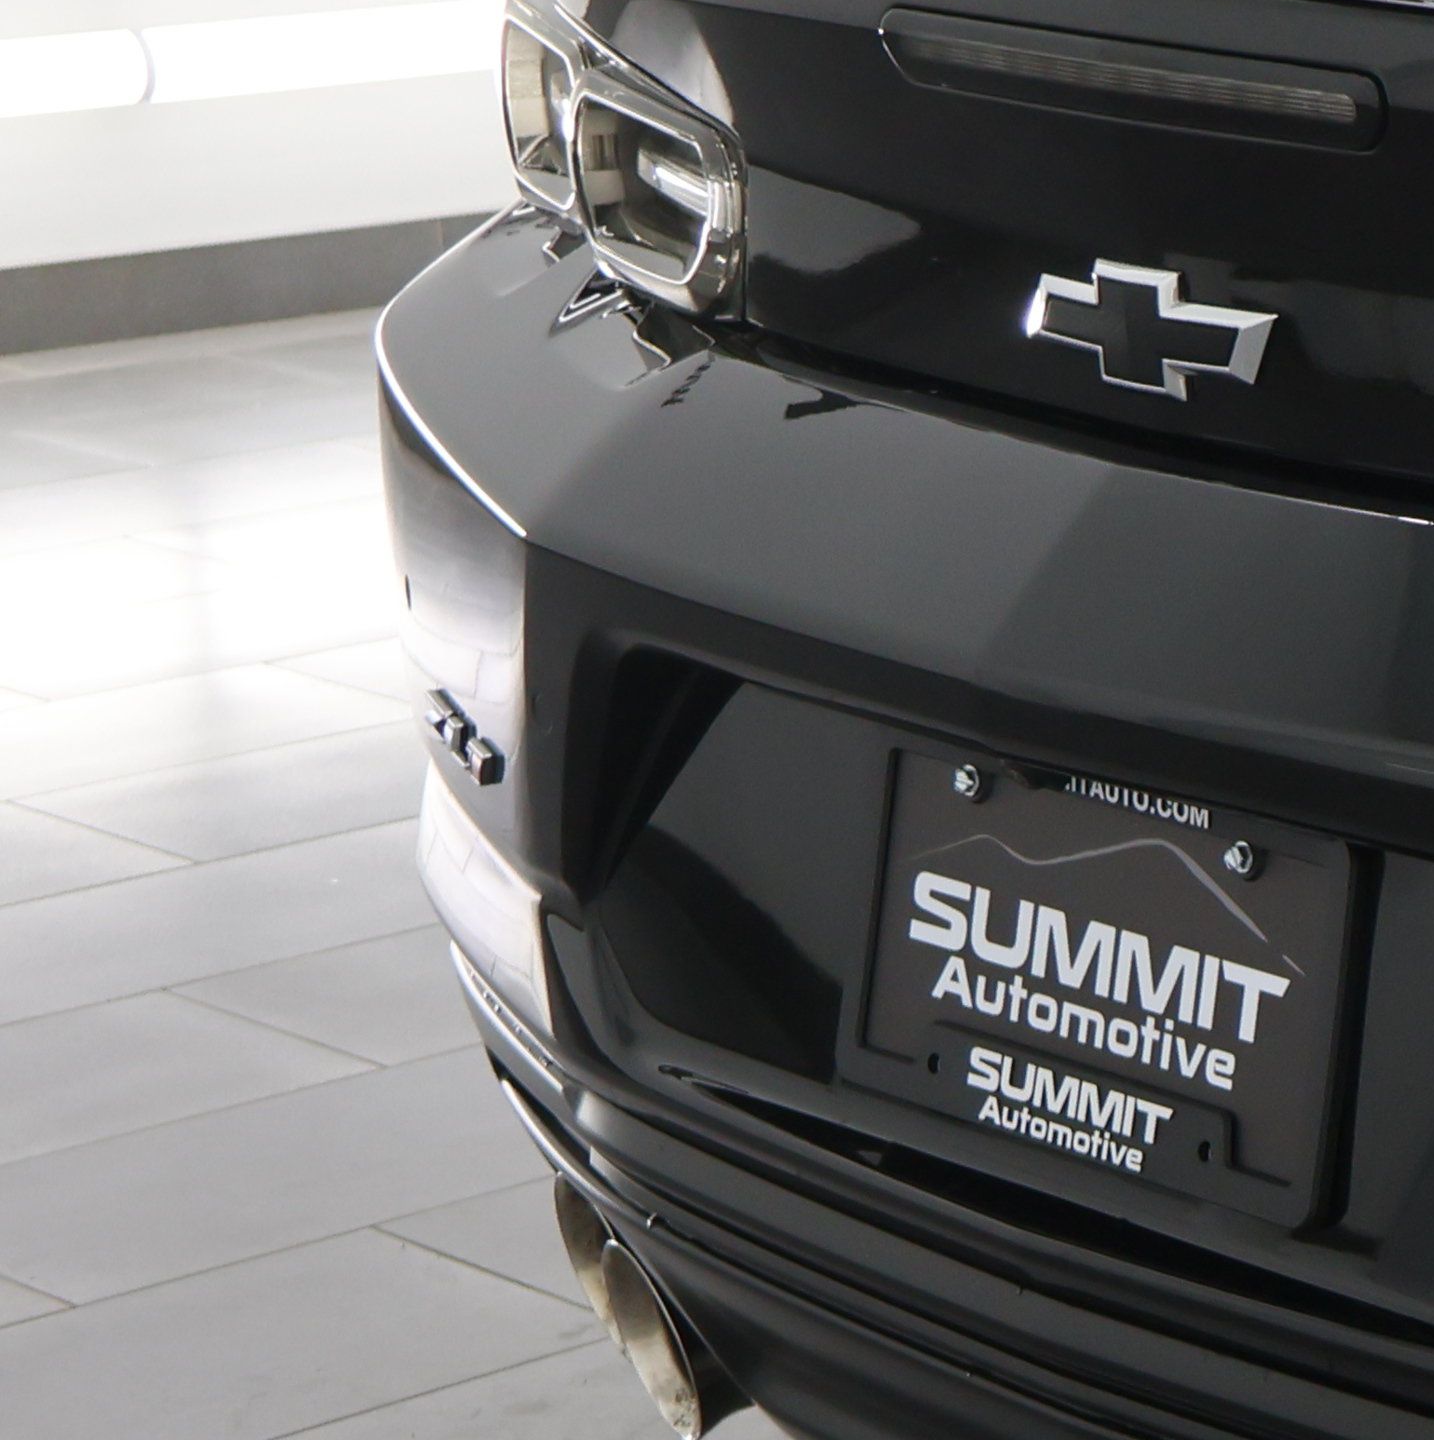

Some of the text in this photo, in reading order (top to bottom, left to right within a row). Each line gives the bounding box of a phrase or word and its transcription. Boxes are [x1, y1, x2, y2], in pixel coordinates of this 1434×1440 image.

[908, 870, 1291, 1044] SUMMIT
[931, 955, 1237, 1091] Automotive
[966, 1046, 1174, 1145] SUMMIT
[978, 1095, 1143, 1173] Automotive
